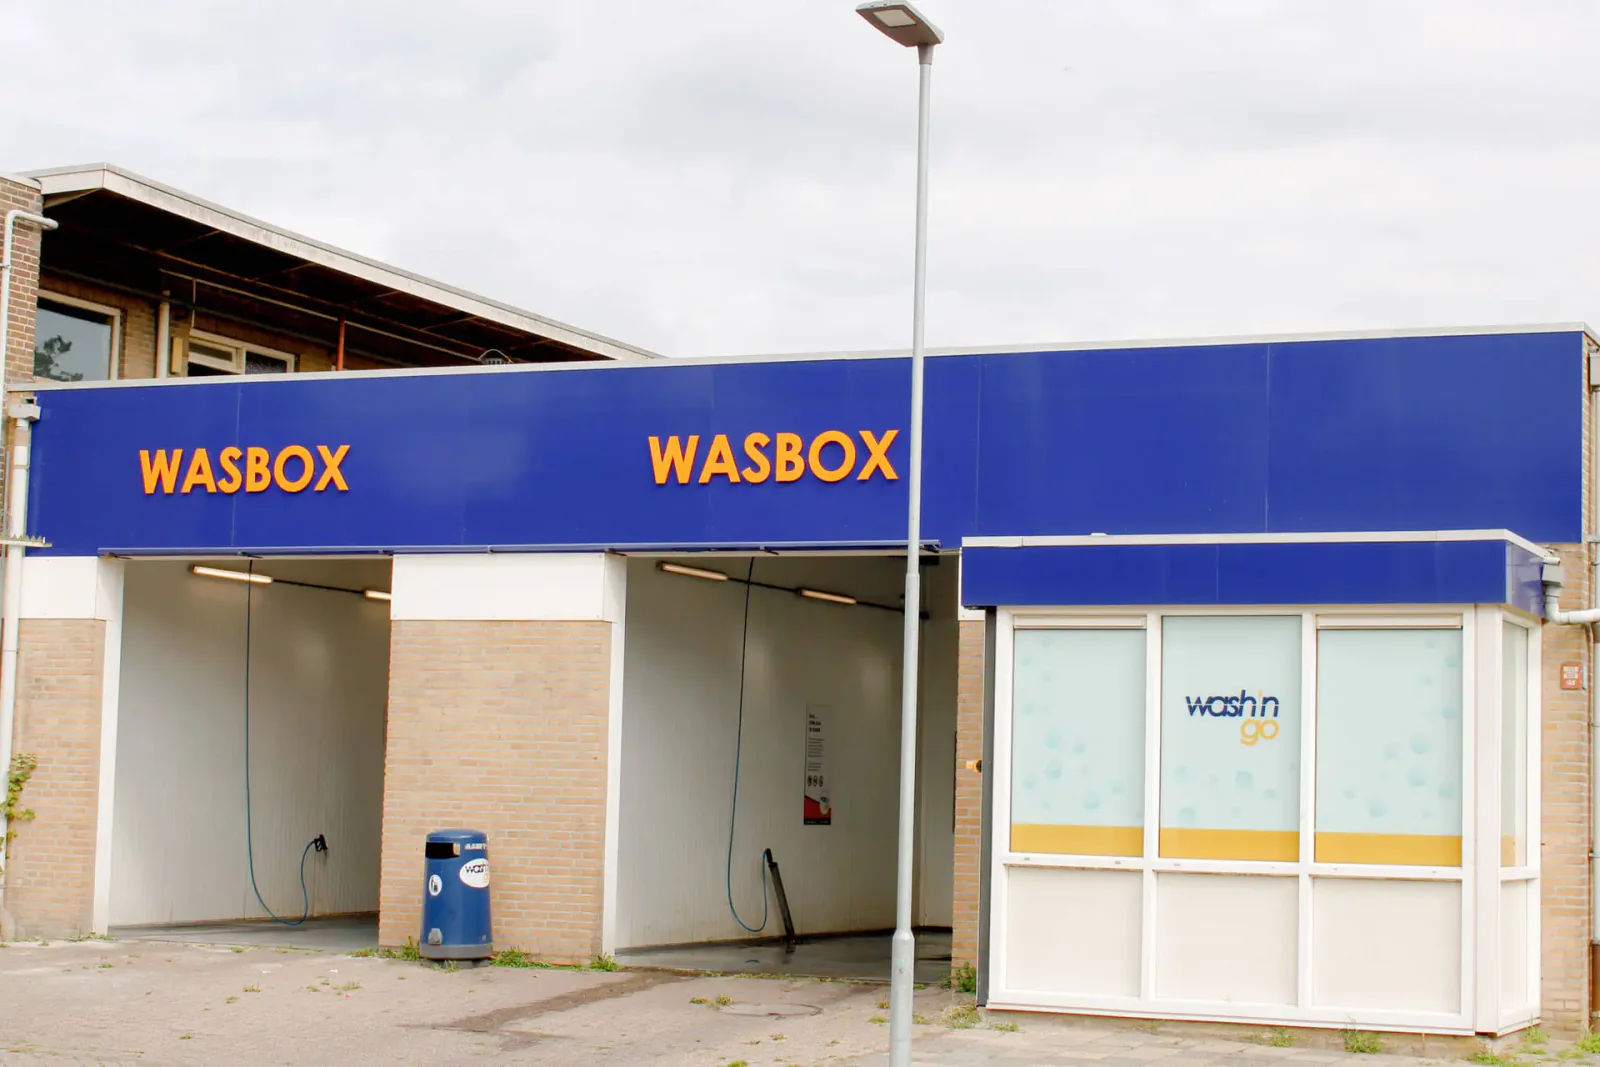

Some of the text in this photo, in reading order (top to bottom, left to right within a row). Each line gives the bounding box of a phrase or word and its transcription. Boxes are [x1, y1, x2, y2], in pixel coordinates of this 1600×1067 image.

[139, 444, 350, 494] WASBOX
[648, 429, 898, 484] WASBOX
[1240, 718, 1280, 747] go
